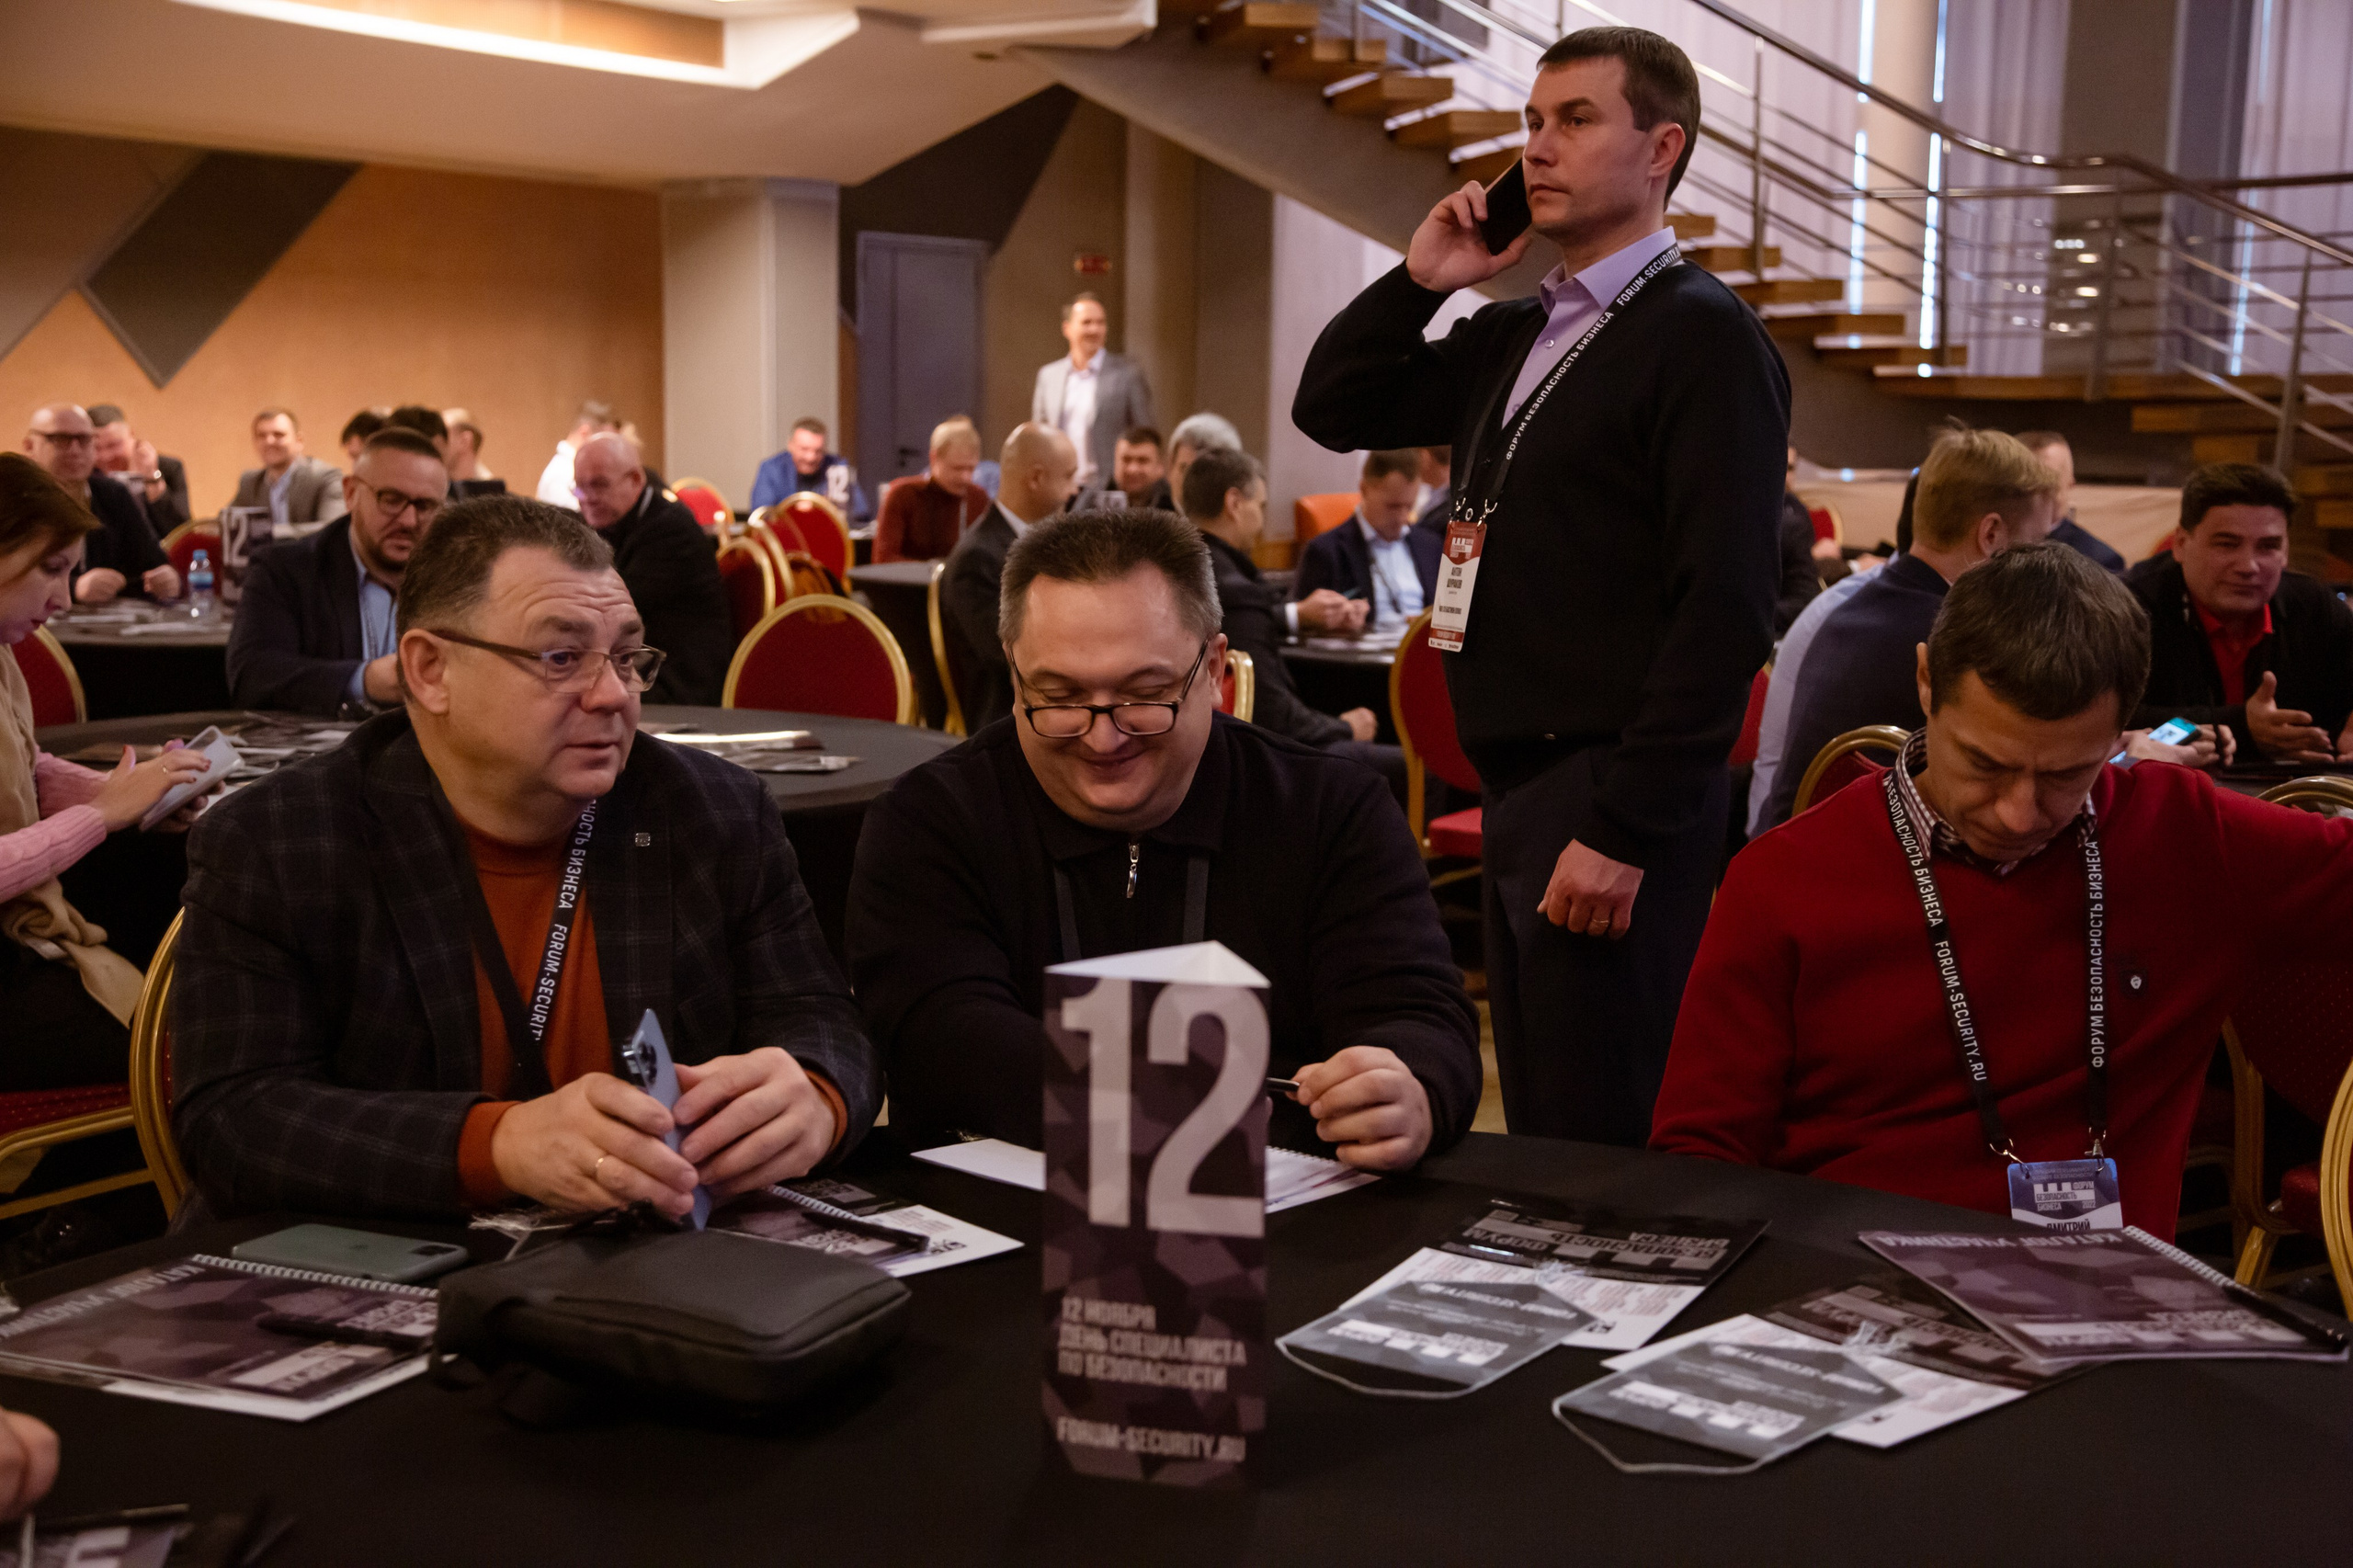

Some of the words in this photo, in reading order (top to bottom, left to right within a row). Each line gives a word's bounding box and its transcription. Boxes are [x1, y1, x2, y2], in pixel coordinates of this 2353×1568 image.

[1506, 422, 1528, 460] ФОРУМ
[1525, 350, 1579, 422] БЕЗОПАСНОСТЬ
[1576, 311, 1614, 351] БИЗНЕСА
[575, 799, 597, 846] НОСТЬ
[558, 849, 586, 909] БИЗНЕСА
[1885, 781, 1925, 867] БЕЗОПАСНОСТЬ
[1914, 867, 1943, 927] БИЗНЕСА
[2087, 840, 2105, 900] БИЗНЕСА
[2089, 902, 2105, 1012] БЕЗОПАСНОСТЬ
[1935, 940, 1988, 1082] FORUM-SECURITY.RU
[2091, 1015, 2105, 1068] ФОРУМ
[1062, 977, 1270, 1237] 12
[2036, 1191, 2077, 1201] БЕЗОПАСНОСТЬ
[2037, 1202, 2062, 1211] БИЗНЕСА
[2073, 1181, 2095, 1190] ФОРУМ
